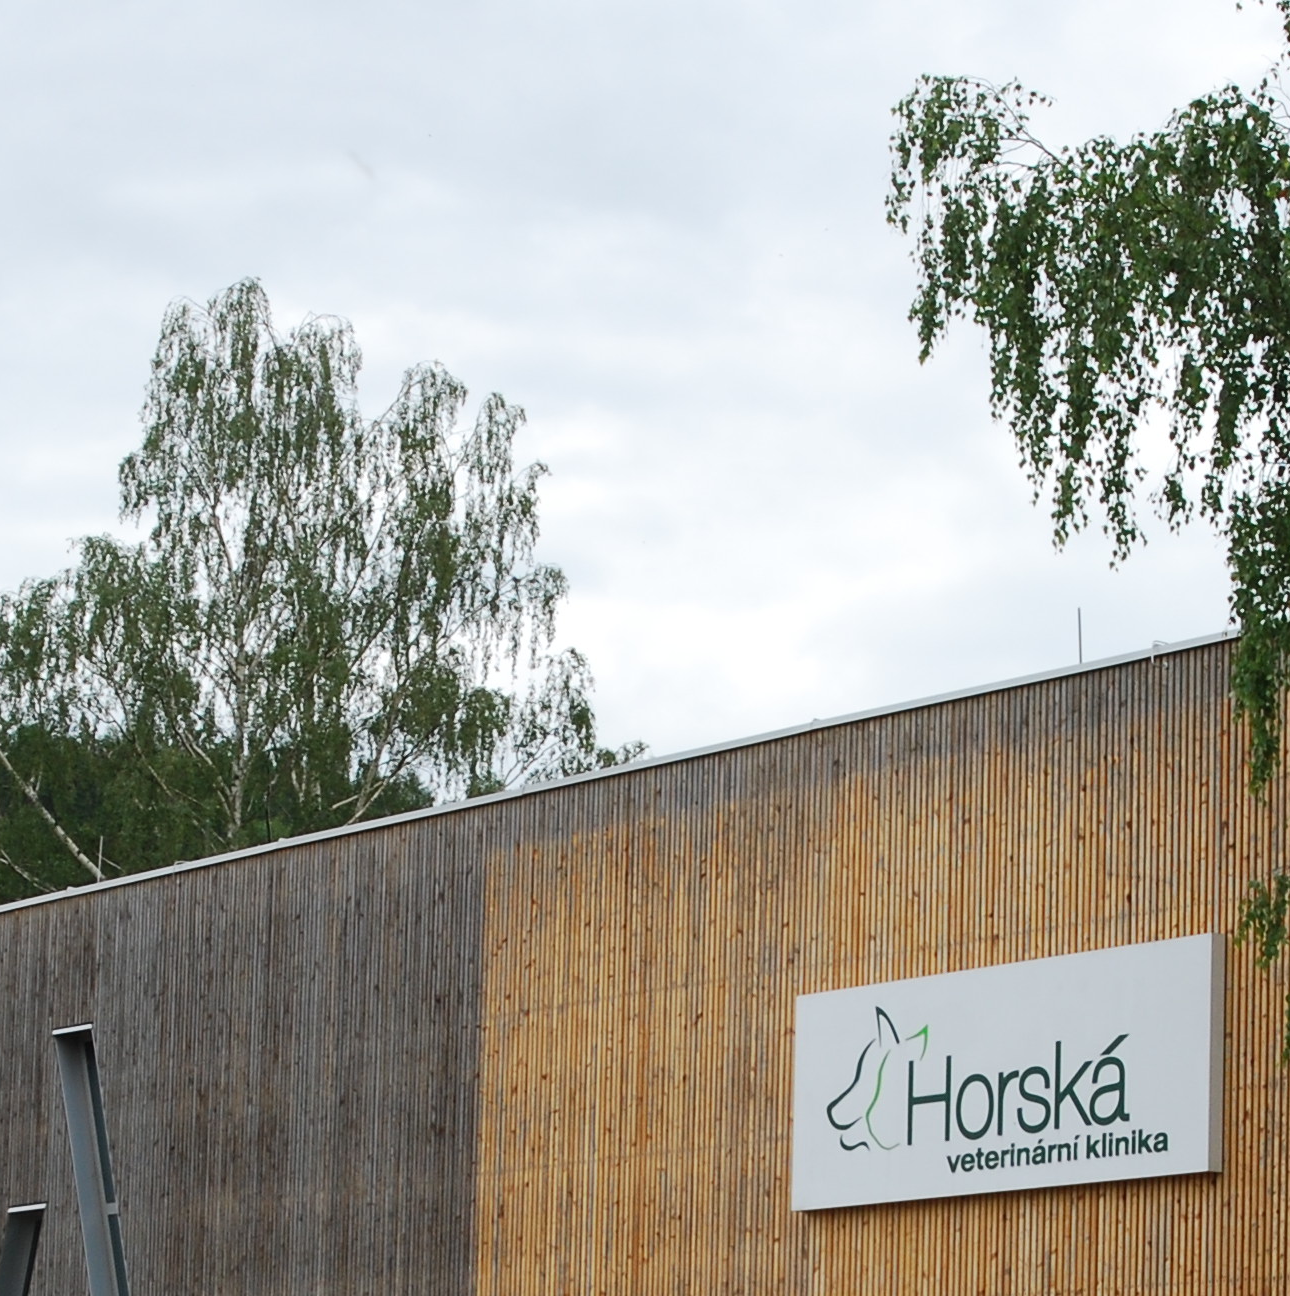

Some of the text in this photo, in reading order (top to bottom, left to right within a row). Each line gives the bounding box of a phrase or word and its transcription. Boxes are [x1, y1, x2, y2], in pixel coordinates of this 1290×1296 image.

[908, 1034, 1131, 1146] Horská
[946, 1129, 1169, 1174] veterinární klinika
